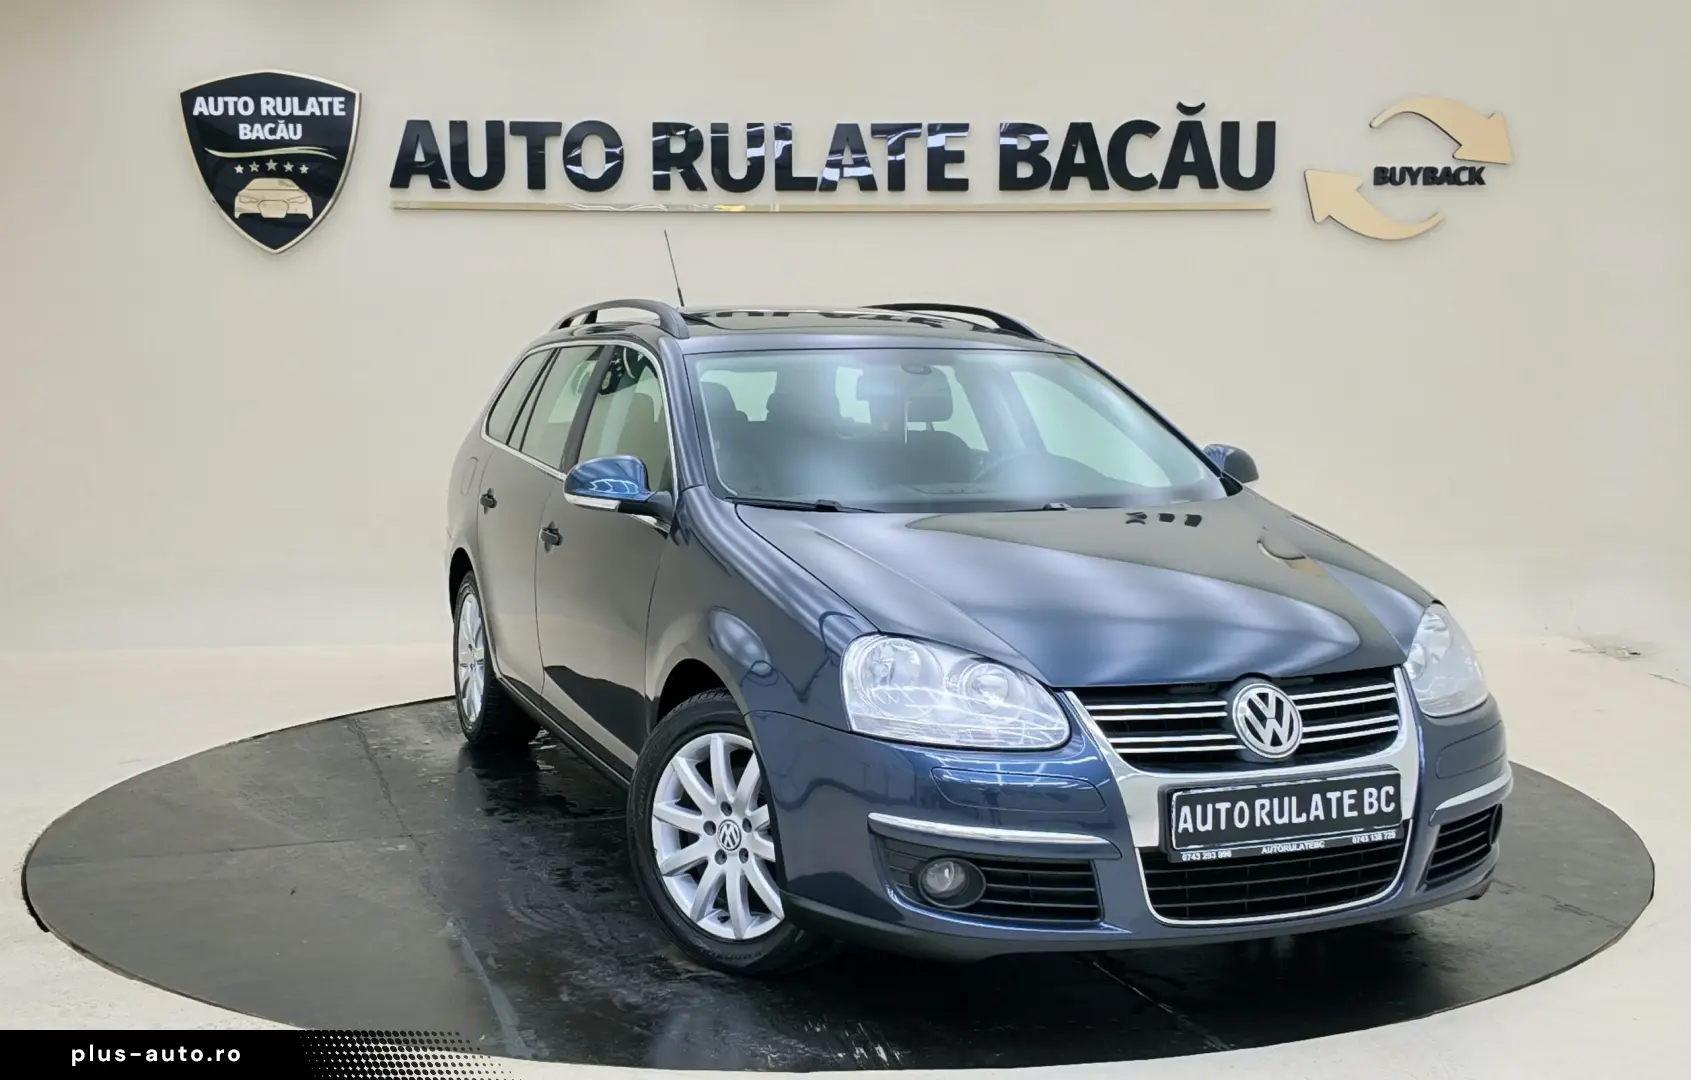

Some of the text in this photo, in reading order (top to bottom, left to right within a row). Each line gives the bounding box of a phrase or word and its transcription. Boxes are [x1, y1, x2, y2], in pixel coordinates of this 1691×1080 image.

[192, 96, 346, 116] AUTO RULATE
[238, 120, 303, 141] BACĂU
[389, 101, 1276, 193] AUTO RULATE BACĂU
[1373, 166, 1486, 186] BUYBACK
[1177, 785, 1396, 834] AUTO RULATE BC
[1261, 840, 1325, 854] AUTORULATEBC
